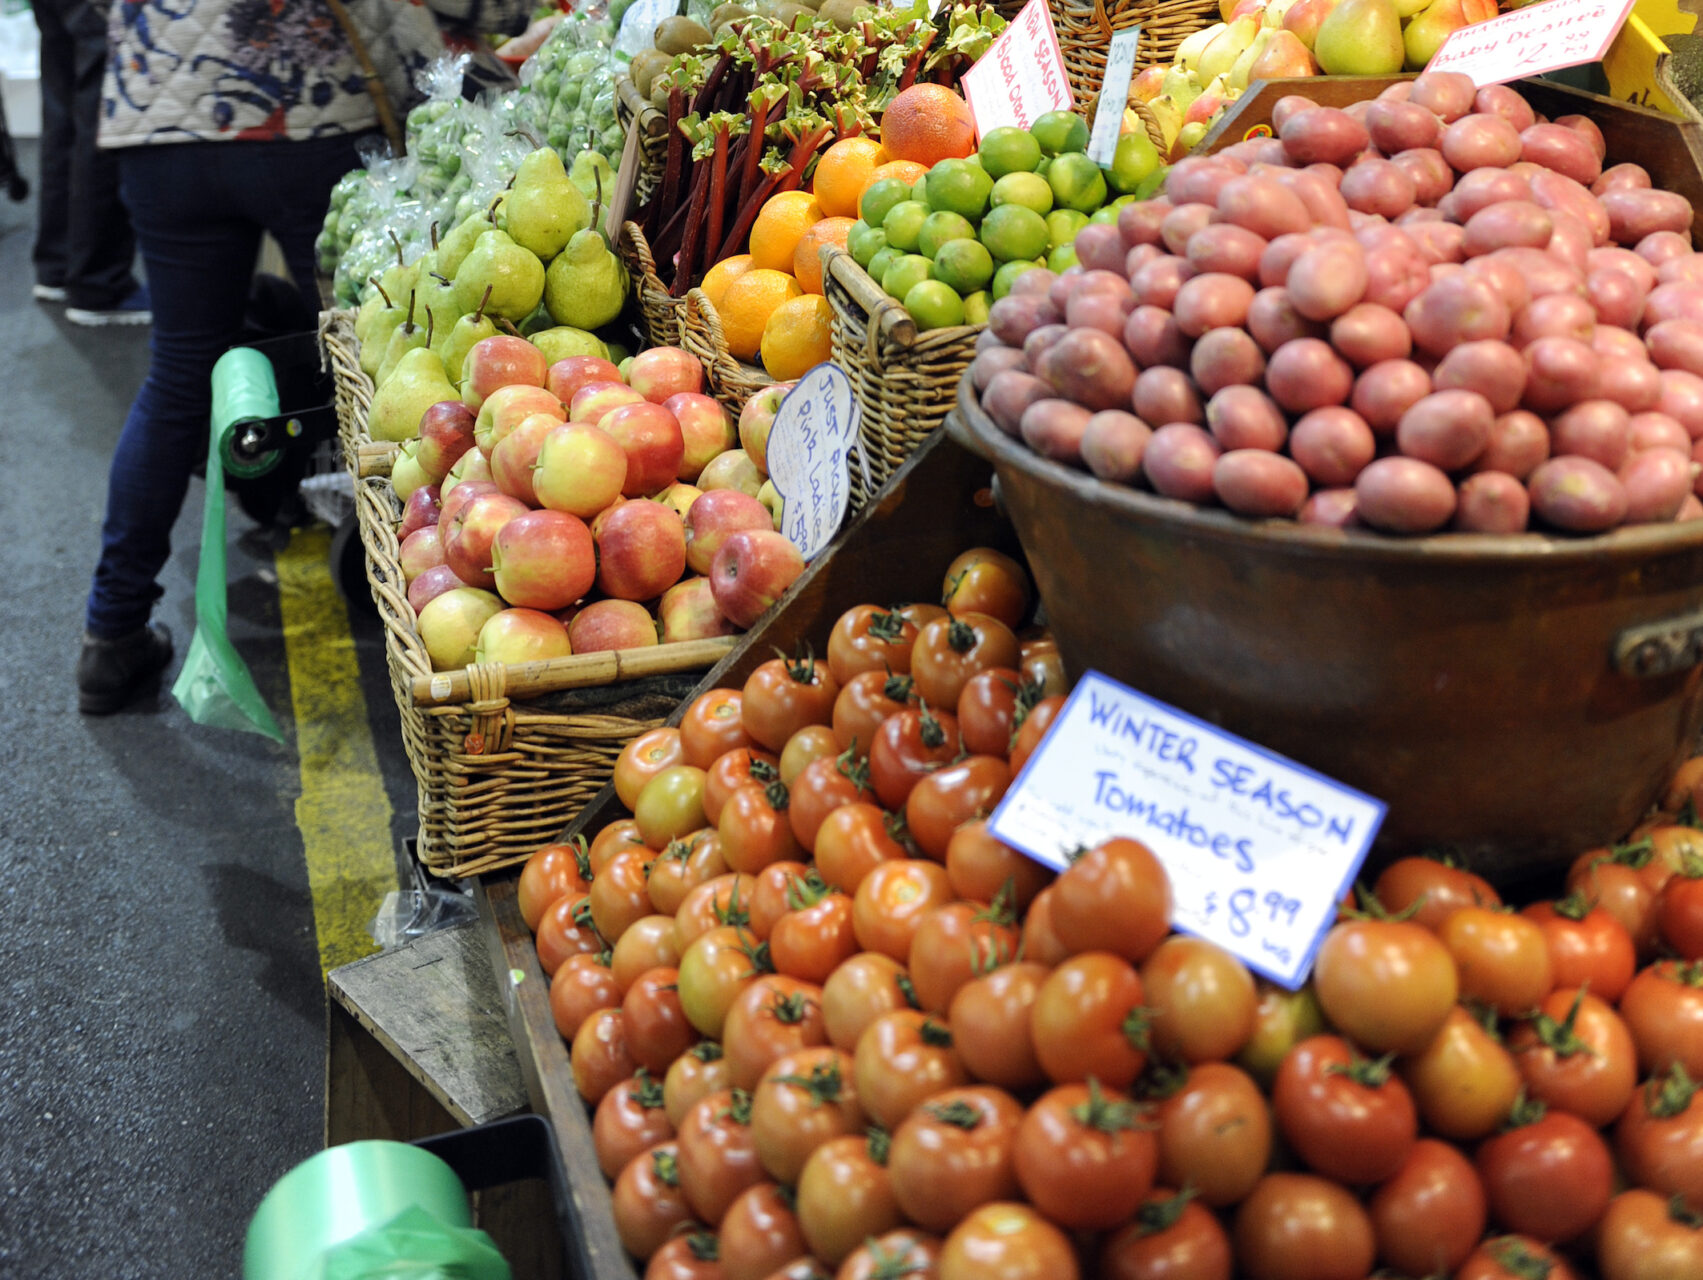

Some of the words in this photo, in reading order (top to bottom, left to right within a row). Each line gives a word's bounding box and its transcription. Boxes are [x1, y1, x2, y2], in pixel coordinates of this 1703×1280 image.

[1024, 2, 1043, 40] NEW
[1034, 38, 1064, 112] SEASON
[1434, 39, 1499, 68] Baby
[797, 399, 818, 463] Pink
[819, 373, 839, 437] JUST
[829, 448, 842, 529] PICKED
[1089, 690, 1199, 775] WINTER
[1210, 757, 1355, 844] SEASON
[1094, 770, 1256, 874] Tomatoes
